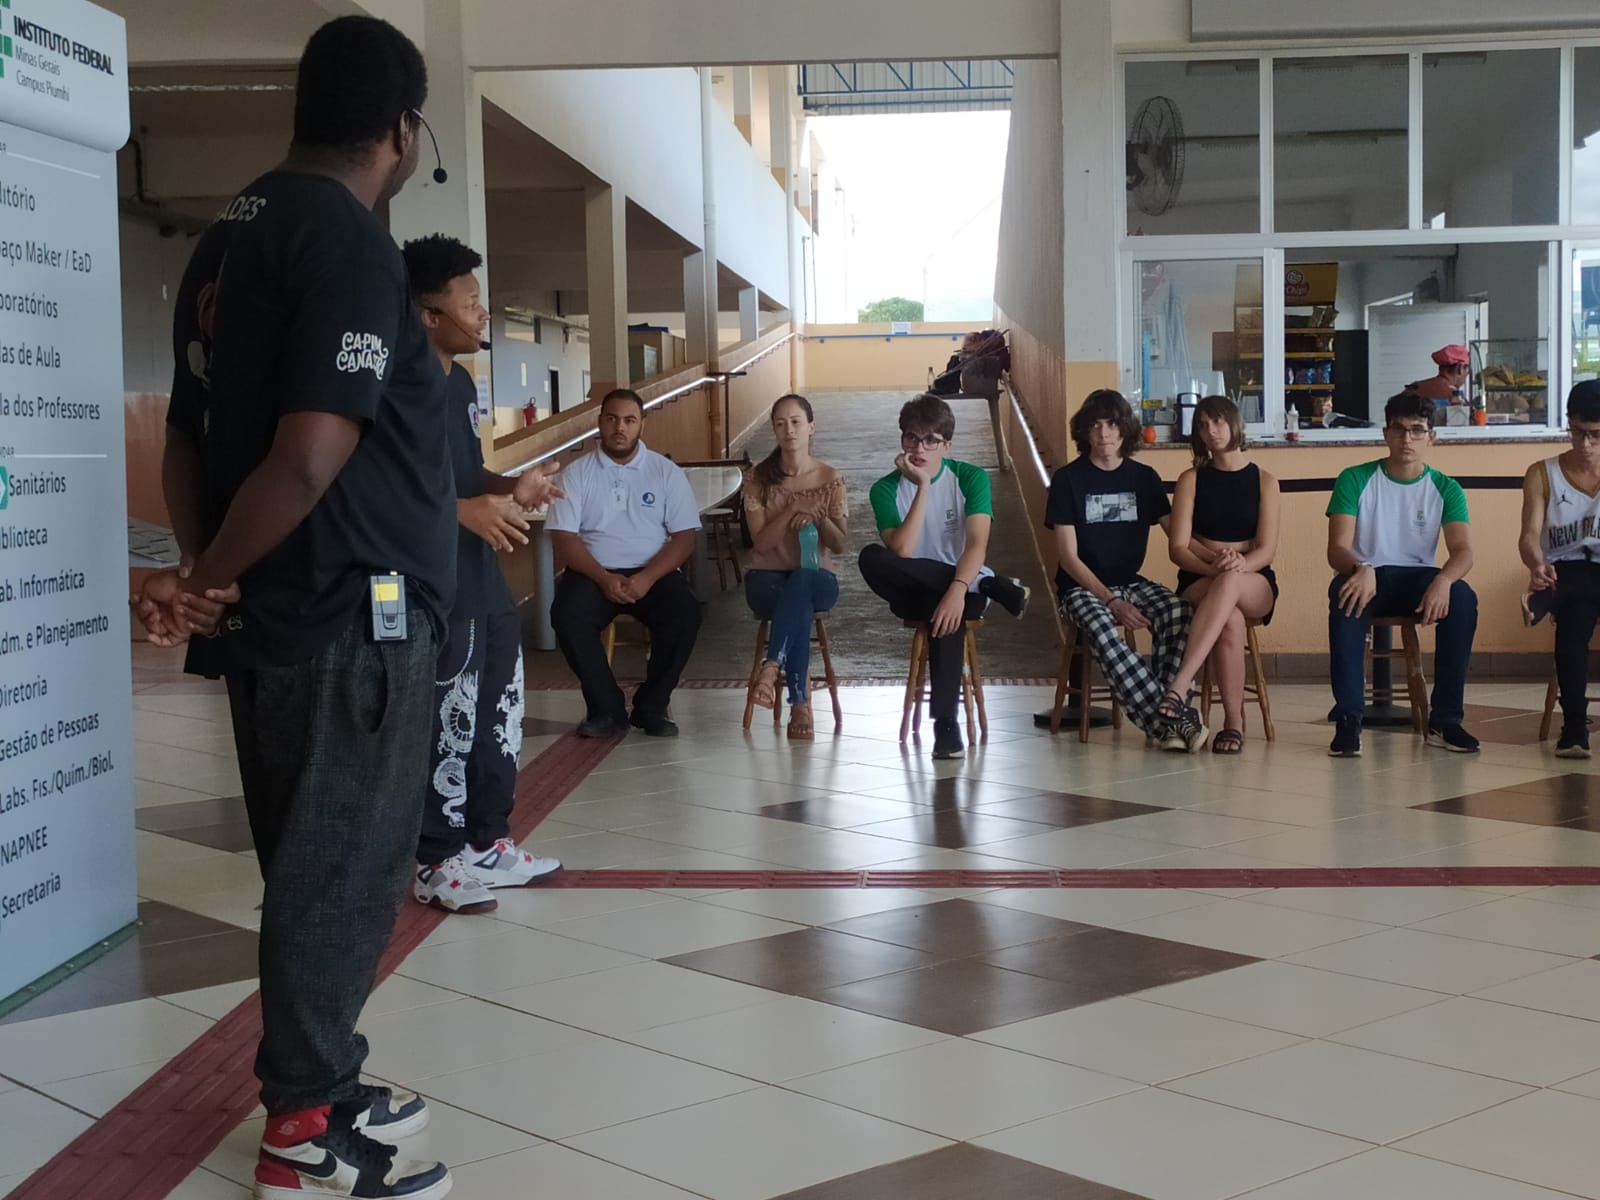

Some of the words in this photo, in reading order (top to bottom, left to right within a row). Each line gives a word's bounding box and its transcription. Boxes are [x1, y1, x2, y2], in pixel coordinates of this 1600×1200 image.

[14, 15, 71, 57] INSTITUTO
[72, 41, 114, 76] FEDERAL
[16, 45, 37, 68] Minas
[38, 54, 61, 77] Gerais
[16, 69, 46, 94] Campus
[46, 80, 70, 102] Piumhi
[0, 240, 22, 267] aço
[26, 240, 62, 268] Maker
[64, 249, 70, 270] /
[72, 250, 92, 273] EaD
[18, 342, 32, 366] de
[36, 345, 61, 368] Aula
[342, 332, 389, 359] CAPIM
[14, 393, 34, 417] dos
[38, 396, 100, 420] Professores
[9, 471, 67, 497] Sanitários
[20, 569, 85, 599] Informática
[0, 631, 24, 655] dm.
[26, 632, 33, 649] e
[36, 614, 109, 647] Planejamento
[0, 730, 38, 761] Gestão
[41, 723, 54, 747] de
[57, 712, 100, 742] Pessoas
[0, 786, 30, 814] Labs.
[1, 825, 48, 867] NAPNEE
[2, 872, 61, 919] Secretaria
